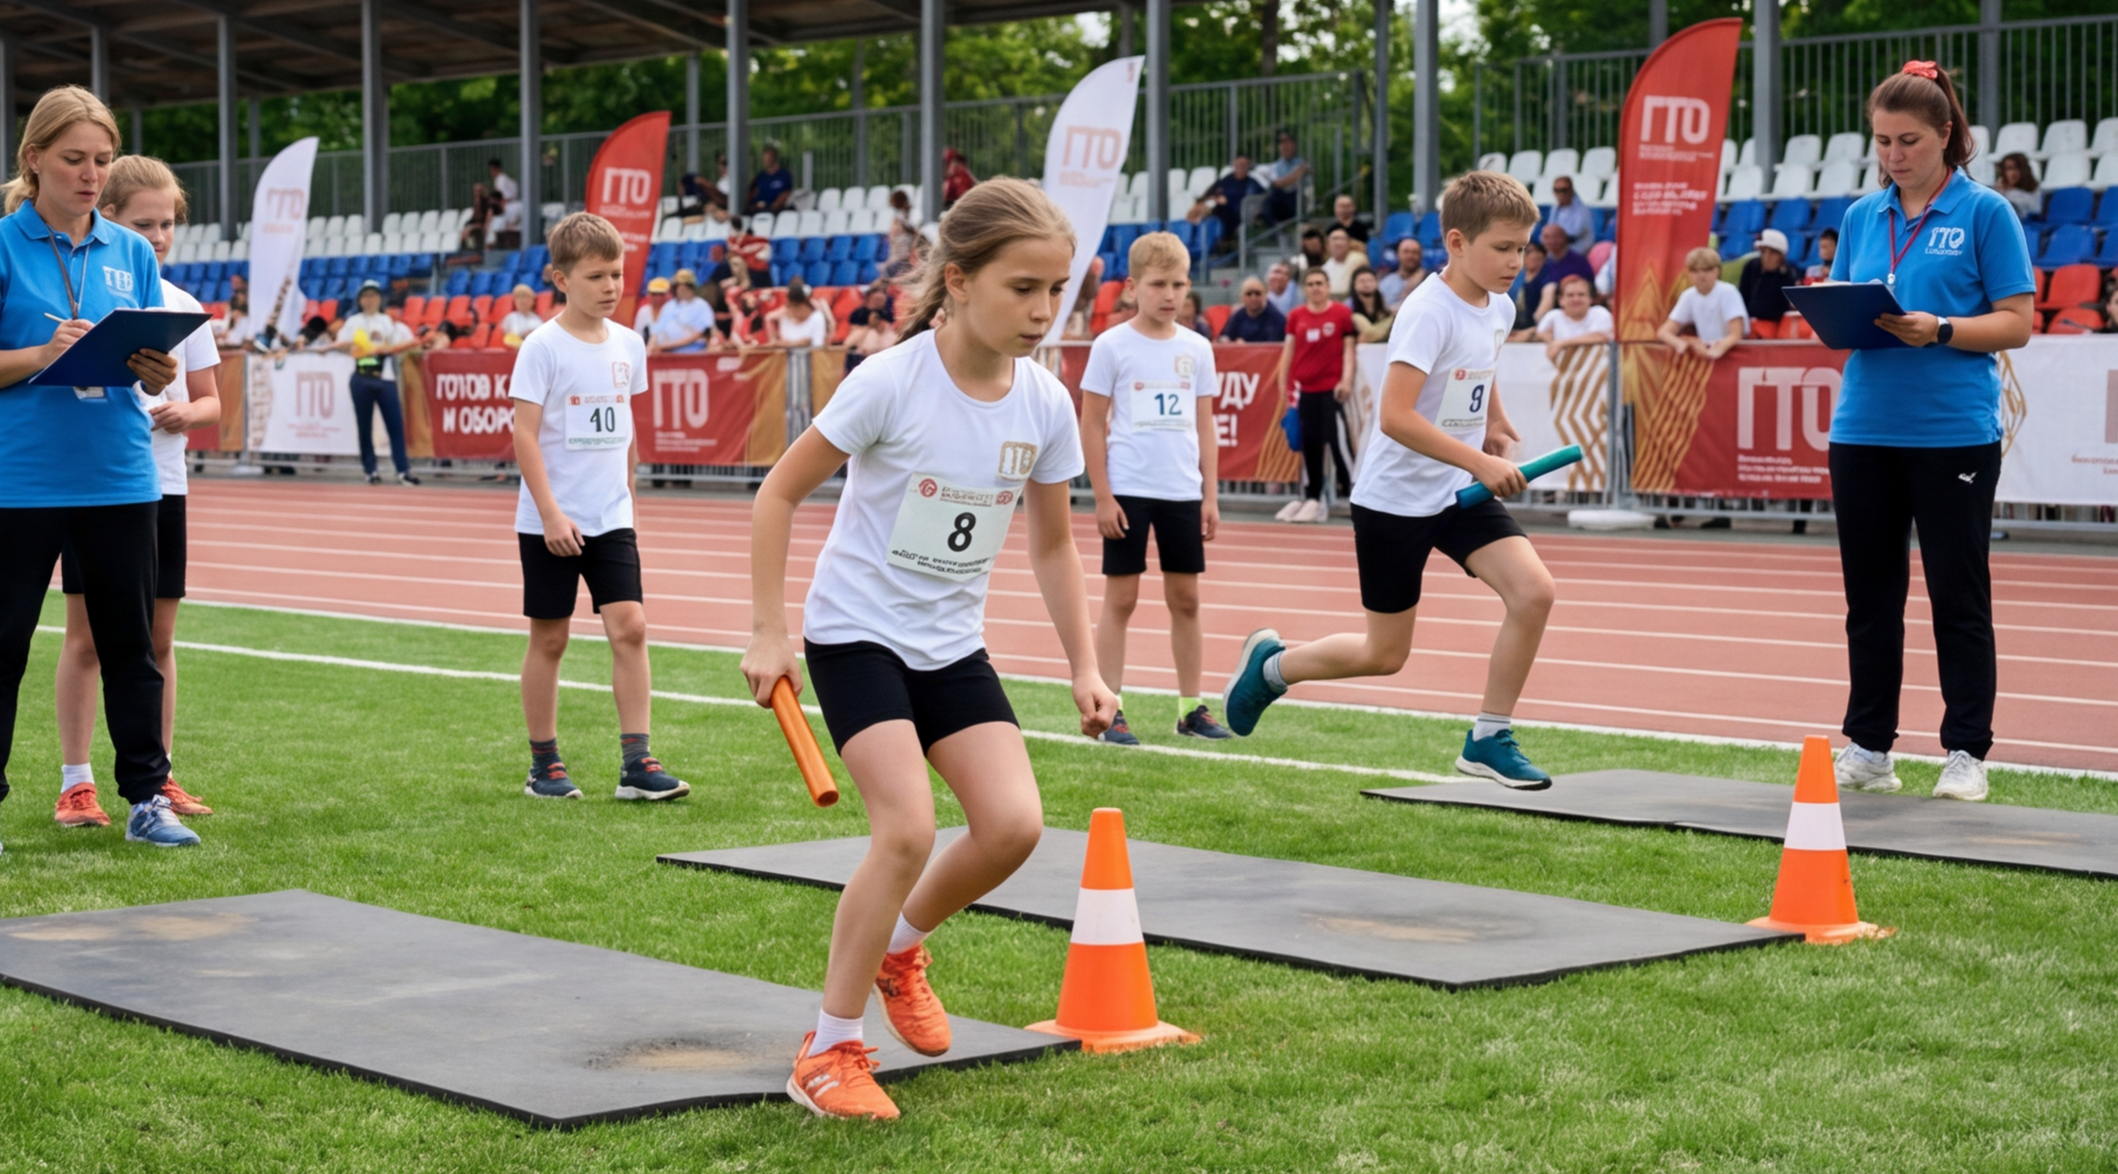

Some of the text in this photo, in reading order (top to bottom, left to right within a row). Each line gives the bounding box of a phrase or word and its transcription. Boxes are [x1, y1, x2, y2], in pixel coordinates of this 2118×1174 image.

[1641, 96, 1711, 144] ГТО
[1062, 126, 1122, 169] ГТО
[602, 168, 652, 205] ГТО
[296, 372, 334, 419] ГТО
[653, 371, 709, 429] ГТО
[1154, 393, 1182, 416] 12
[1217, 371, 1261, 411] ДУ
[1469, 384, 1484, 413] 9
[1737, 367, 1842, 452] ГТО
[947, 512, 976, 552] 8
